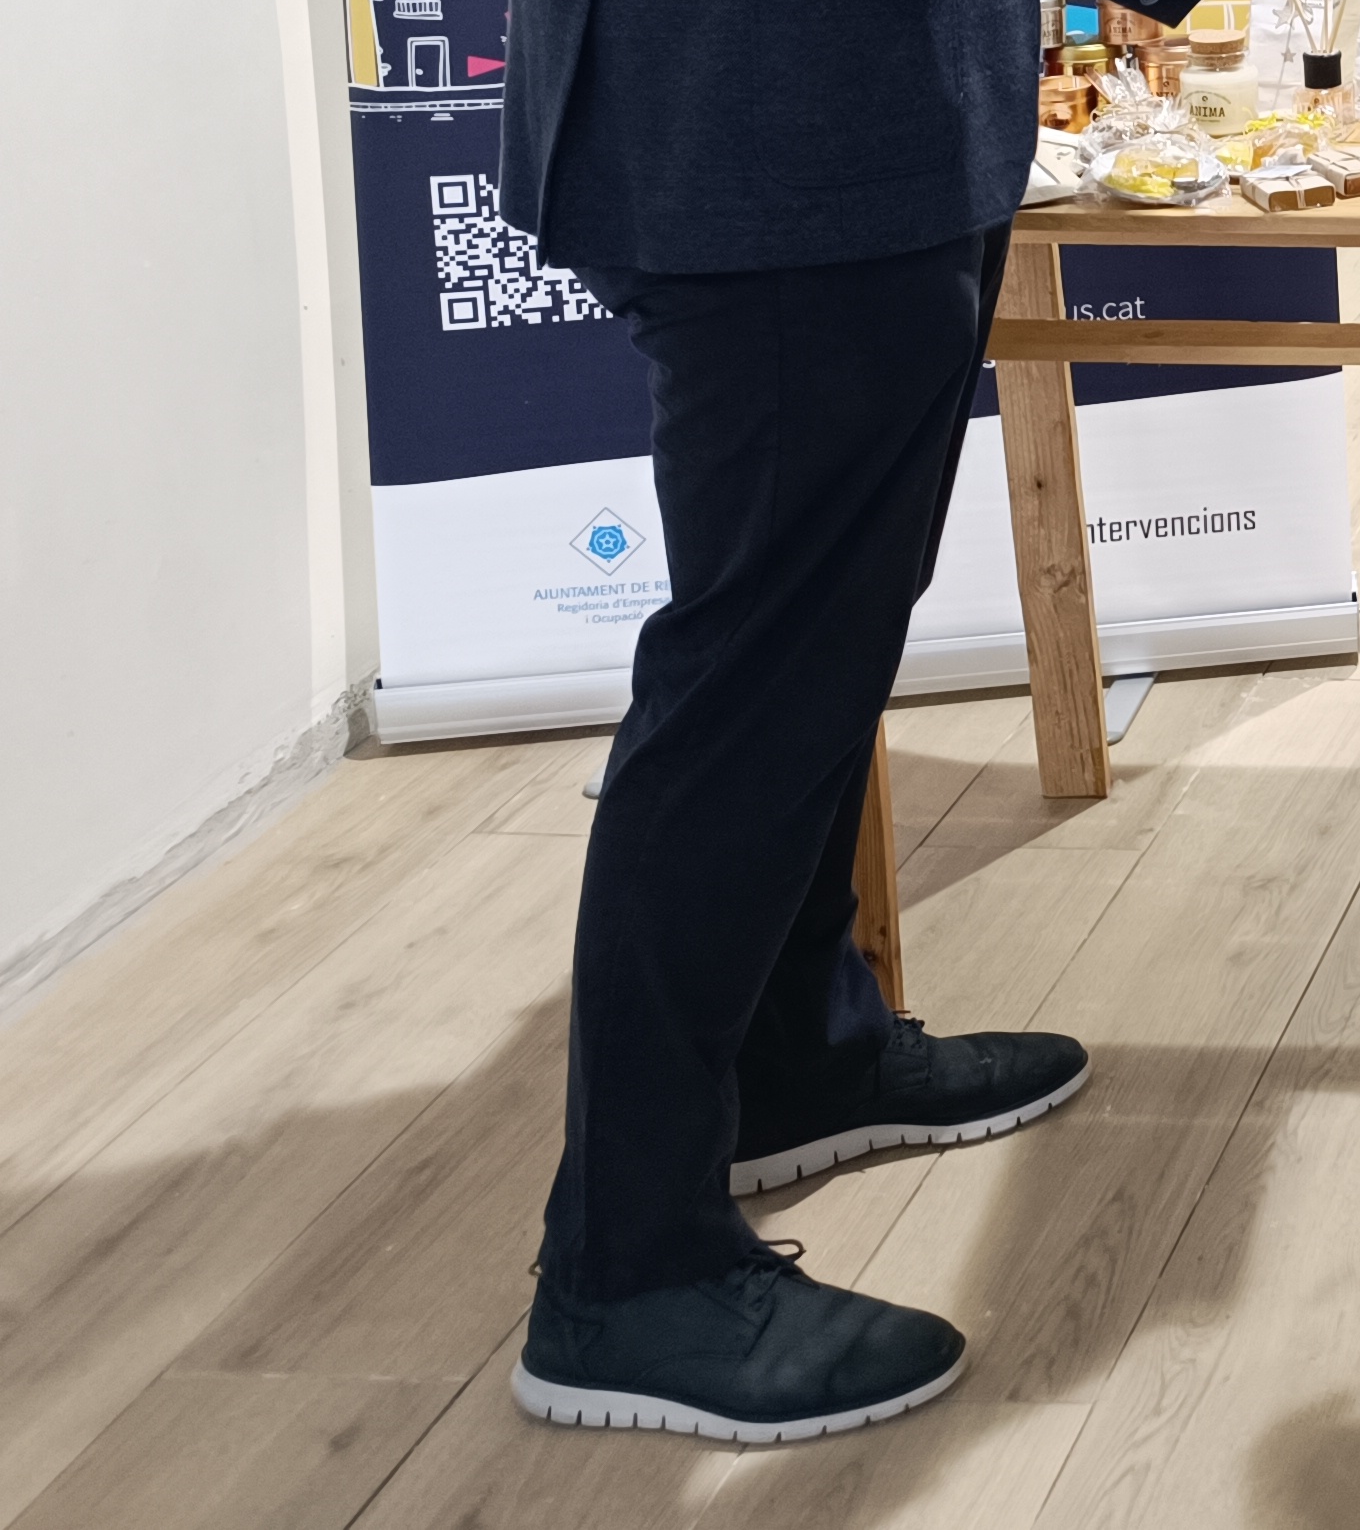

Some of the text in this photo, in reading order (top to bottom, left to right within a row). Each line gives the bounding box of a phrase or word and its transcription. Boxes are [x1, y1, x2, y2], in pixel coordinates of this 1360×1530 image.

[1189, 105, 1226, 118] ANIMA
[1087, 506, 1256, 544] ntervencions
[533, 583, 627, 601] AJUNTAMENT
[631, 582, 650, 594] DE
[557, 600, 609, 614] Regidoria
[592, 610, 644, 624] Ocupació
